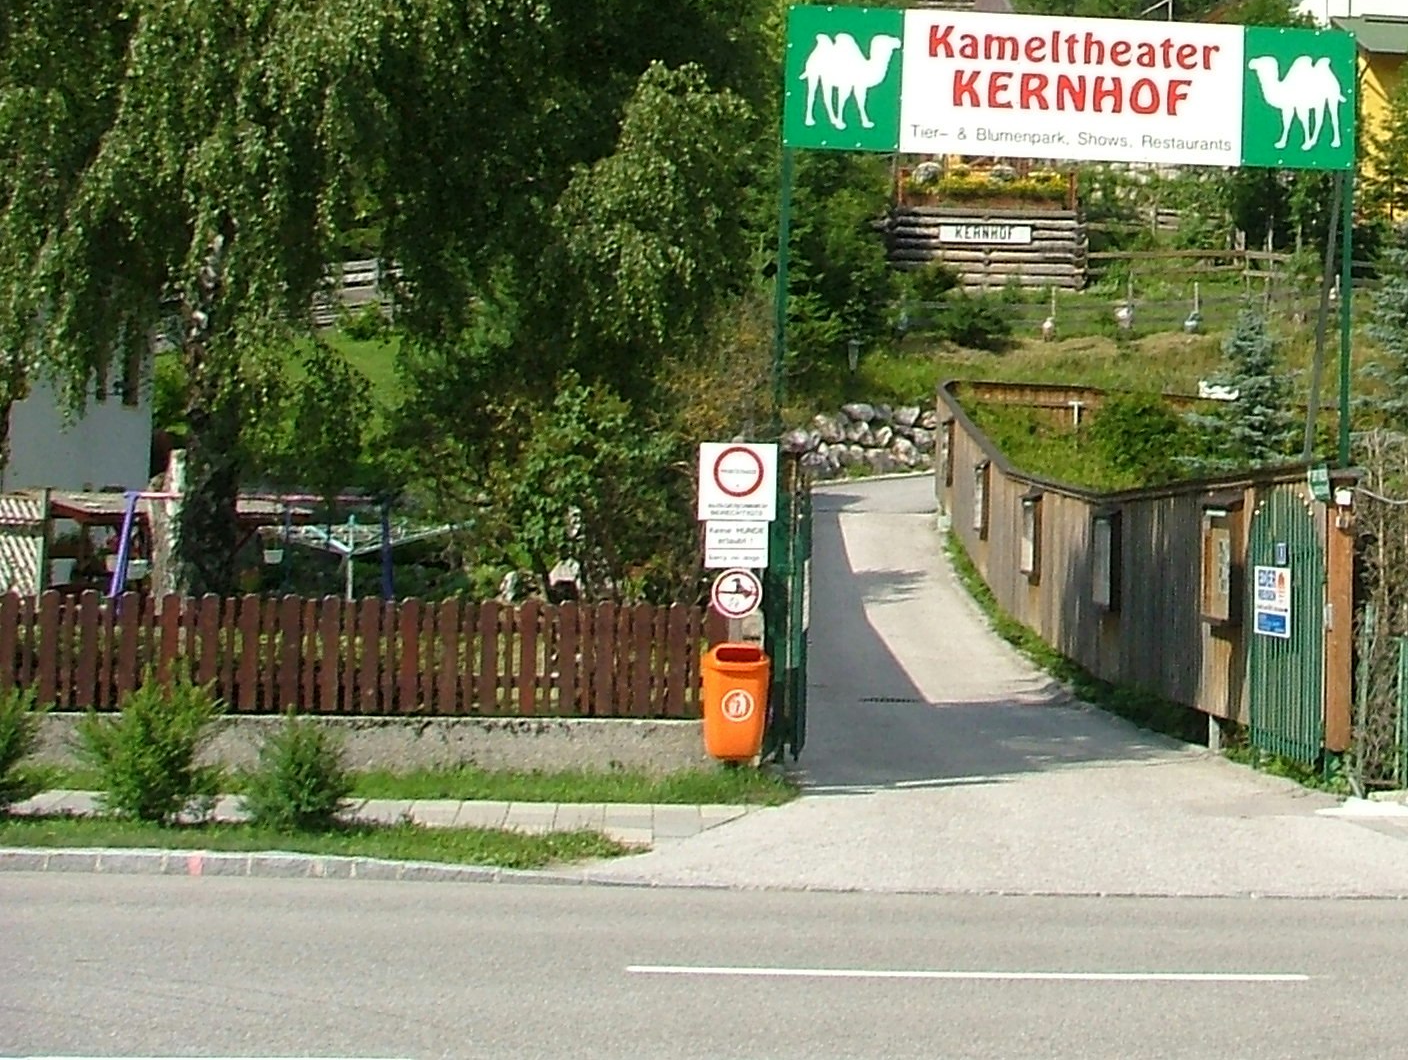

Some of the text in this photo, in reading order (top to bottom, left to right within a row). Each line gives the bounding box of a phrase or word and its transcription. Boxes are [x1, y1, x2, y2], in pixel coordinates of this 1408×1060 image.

[928, 24, 1220, 71] Kameltheater
[952, 69, 1193, 116] KERNHOF
[911, 124, 949, 140] Tier-
[957, 127, 967, 141] &
[1142, 135, 1232, 152] Restaurants
